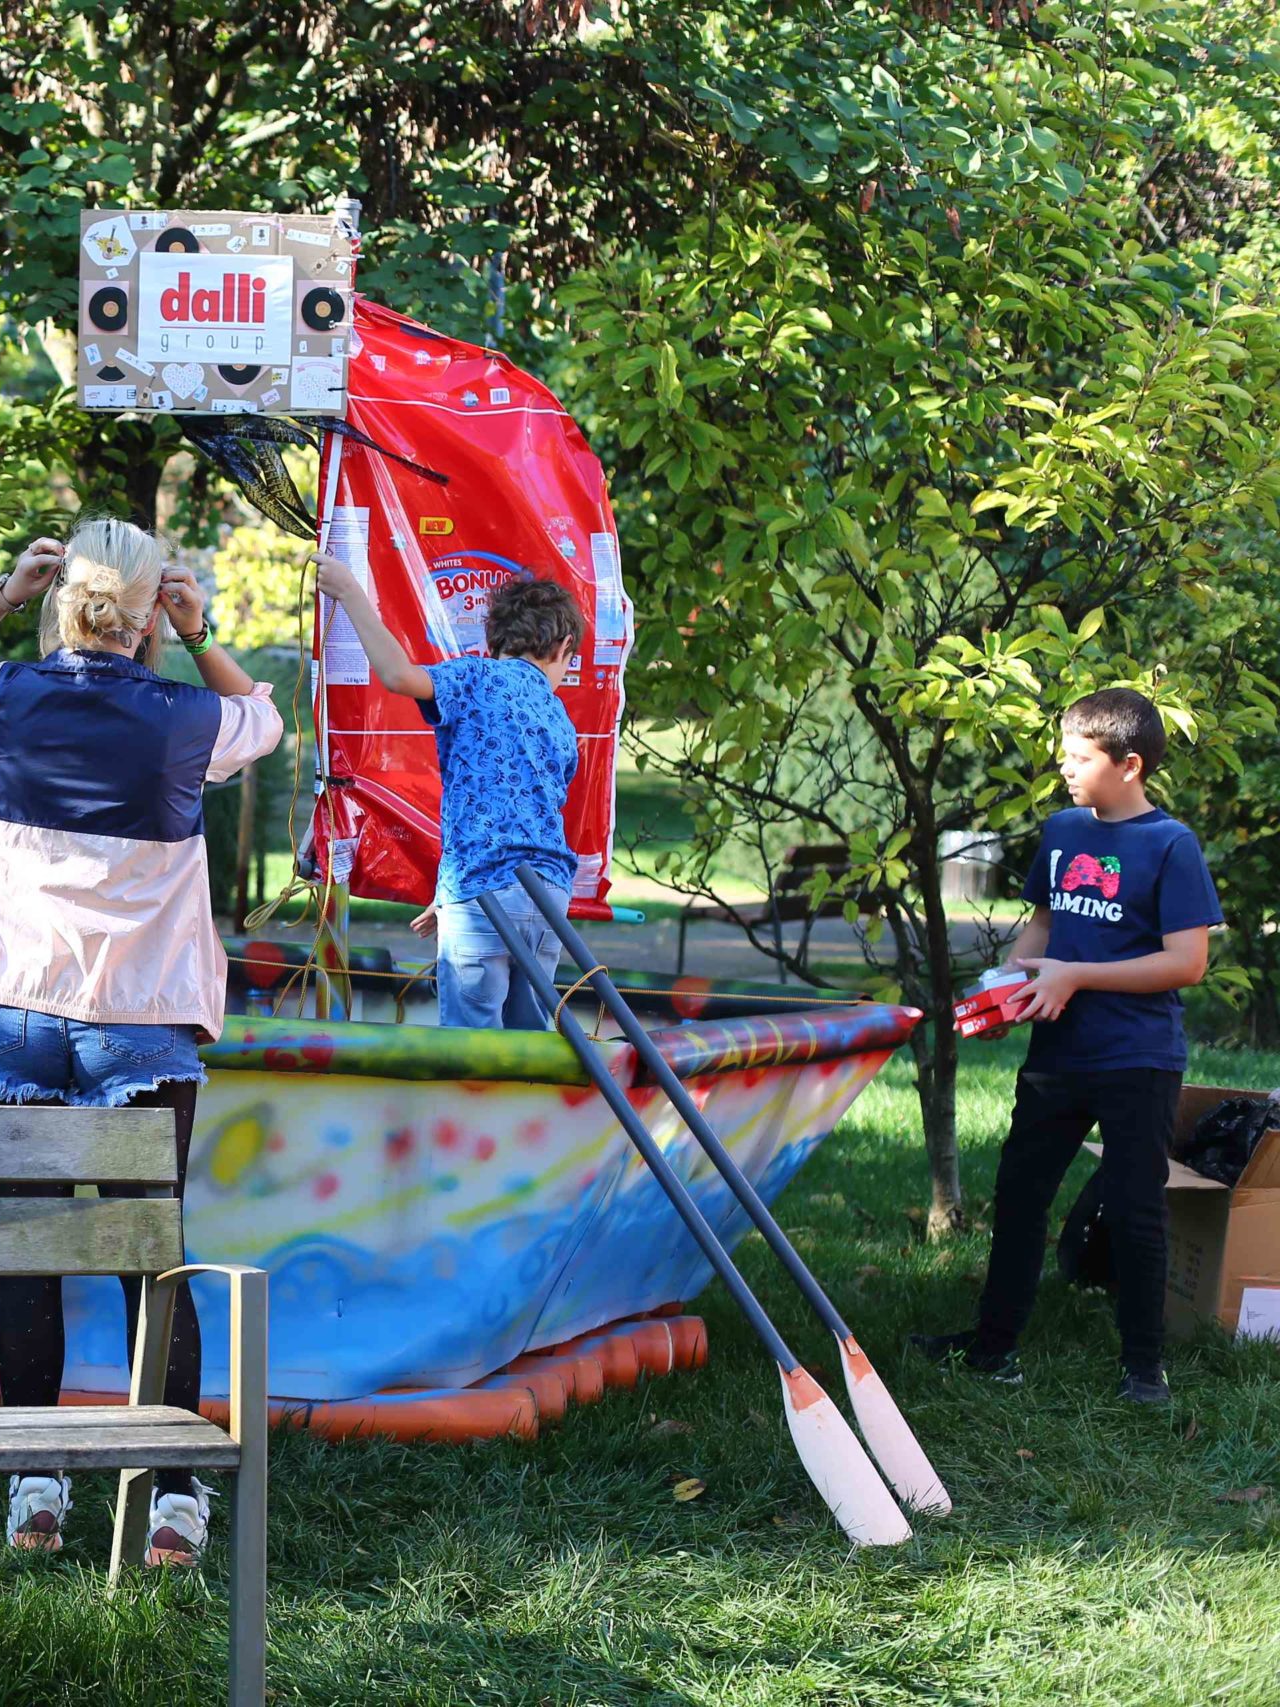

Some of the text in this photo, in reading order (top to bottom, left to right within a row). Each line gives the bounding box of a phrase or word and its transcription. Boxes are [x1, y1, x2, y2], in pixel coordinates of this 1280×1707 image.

[160, 271, 267, 323] dalli
[160, 332, 265, 353] group
[433, 559, 462, 569] WHITES
[463, 594, 475, 611] 3
